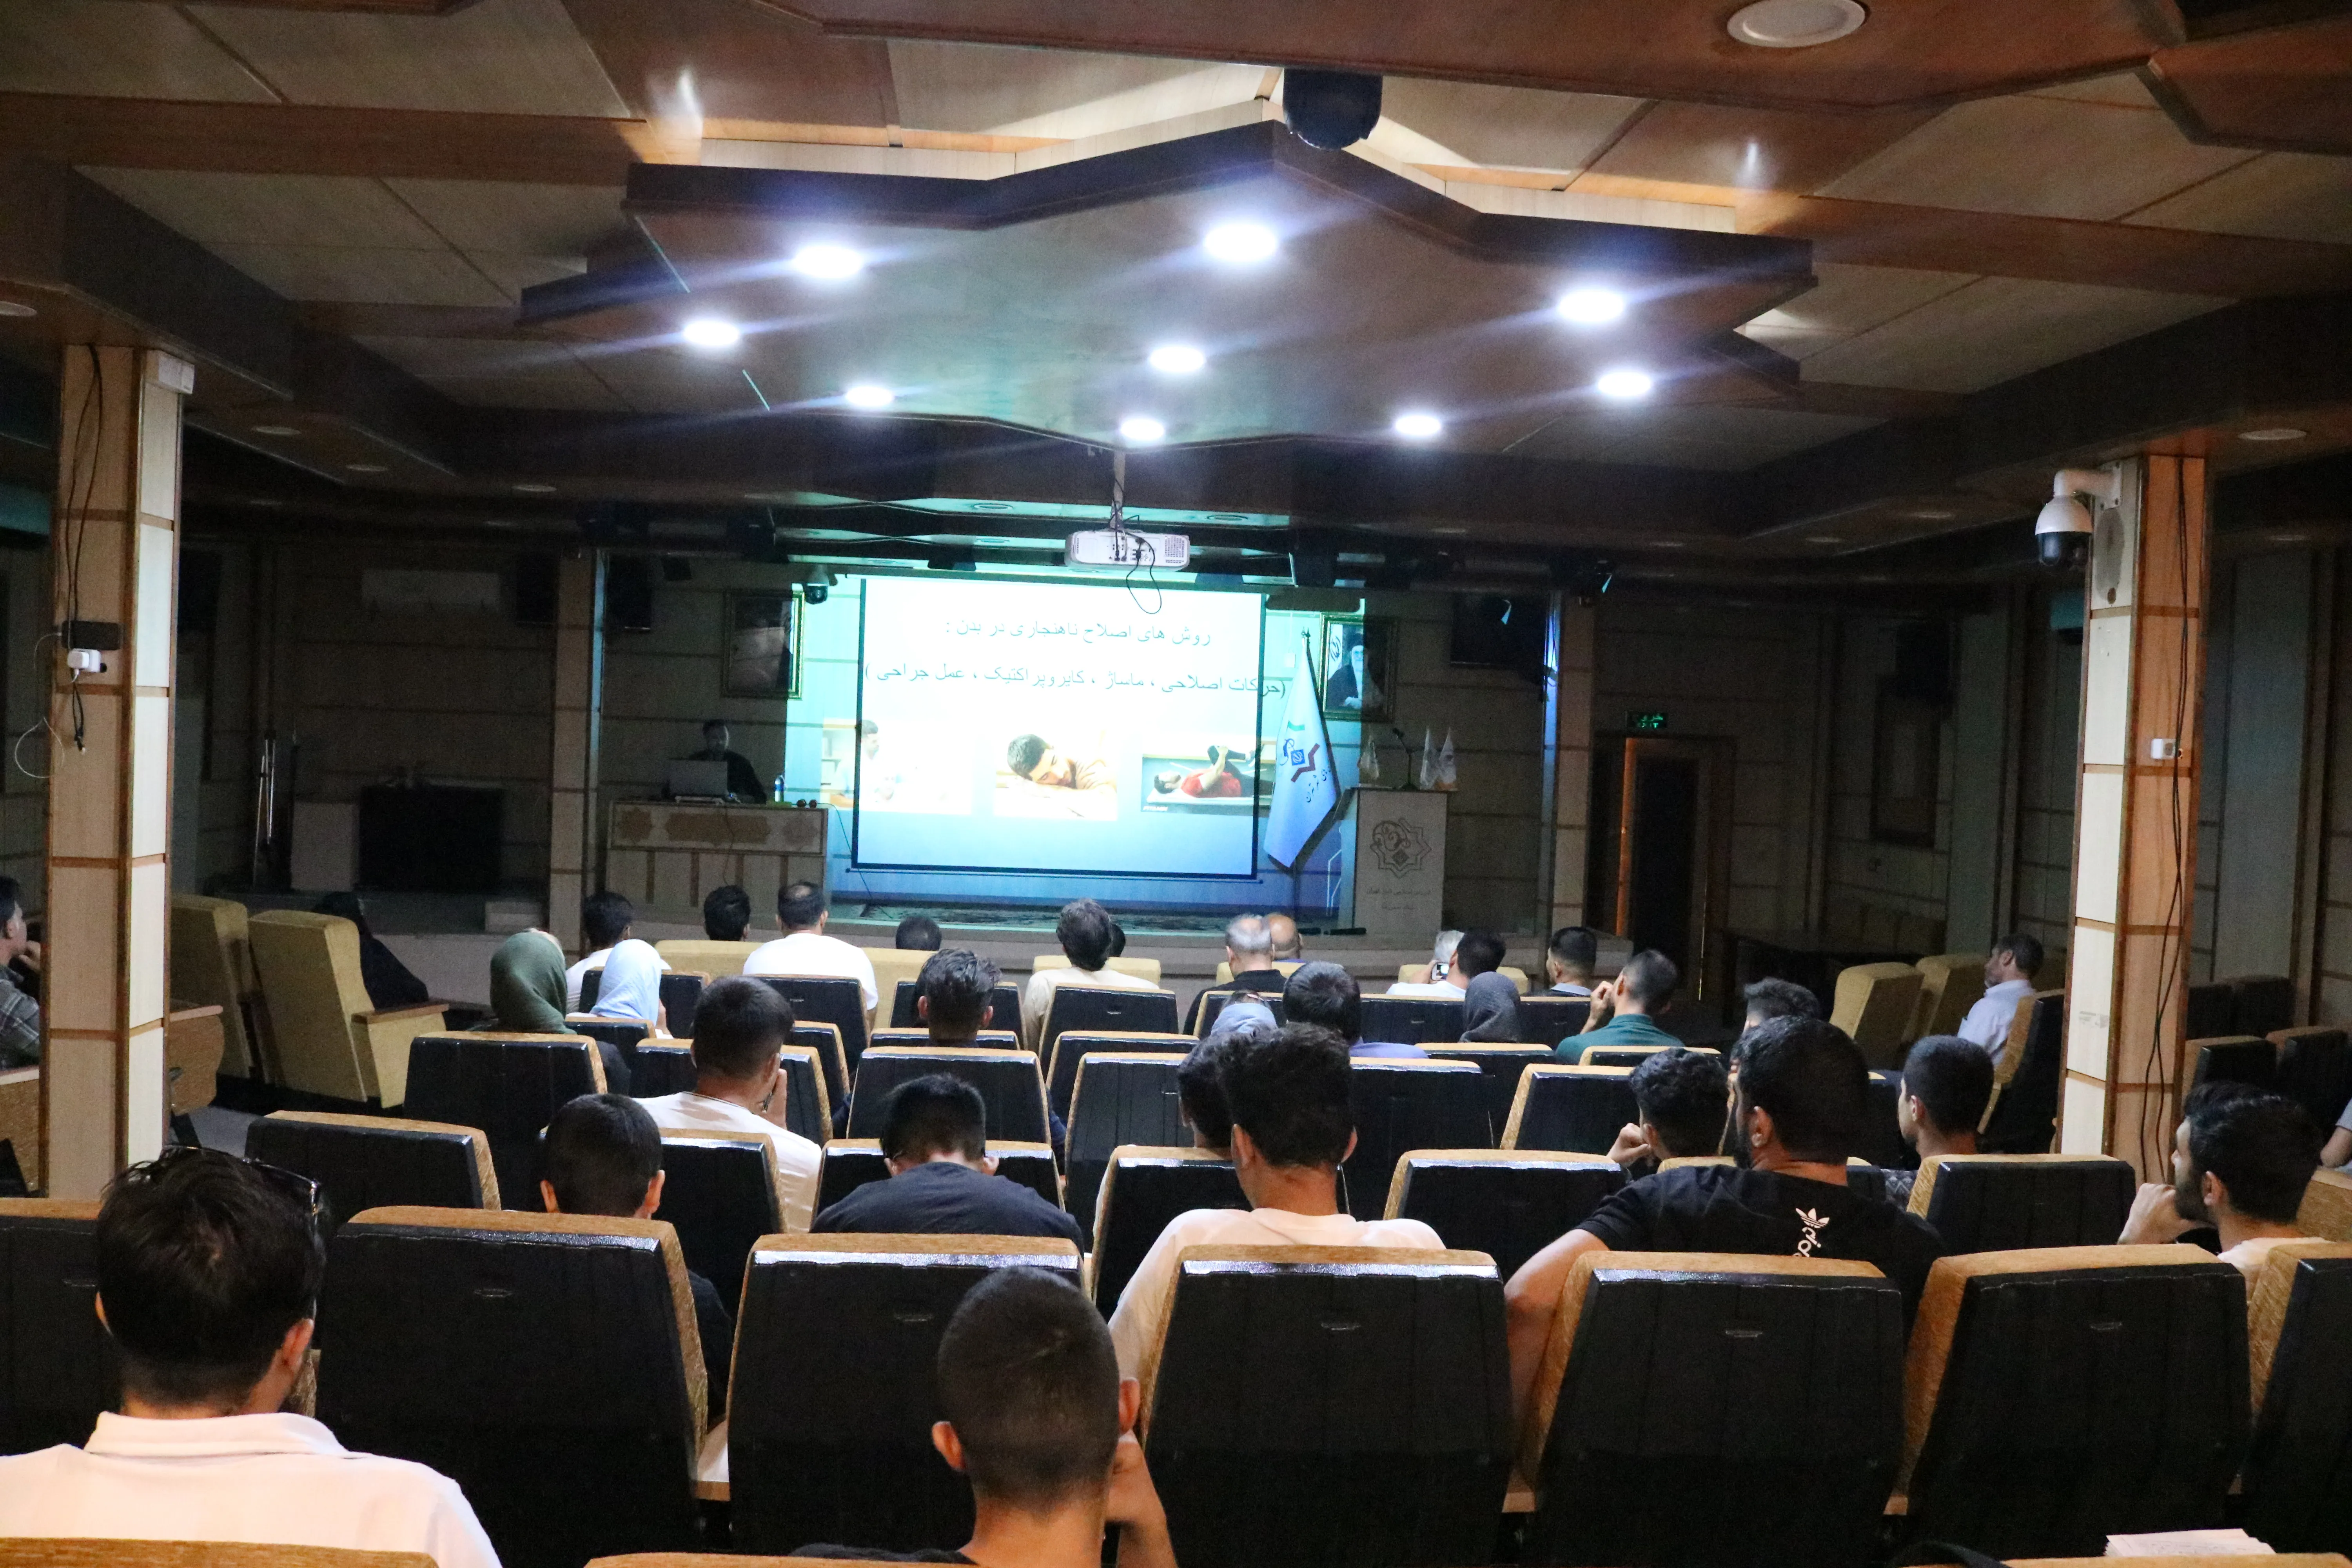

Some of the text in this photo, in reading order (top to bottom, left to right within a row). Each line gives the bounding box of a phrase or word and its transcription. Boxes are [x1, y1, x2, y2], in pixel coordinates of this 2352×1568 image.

[956, 620, 981, 635] بدن
[988, 623, 1005, 637] در
[1010, 621, 1078, 638] ناهنجاری
[1083, 622, 1131, 644] اصلاح
[1138, 626, 1165, 642] های
[1172, 626, 1210, 646] روش
[877, 663, 929, 681] جراحی
[935, 663, 965, 680] عمل
[984, 666, 1085, 689] کایروپراکتیک
[1105, 671, 1144, 690] ماساژ
[1161, 675, 1222, 693] اصلاحی
